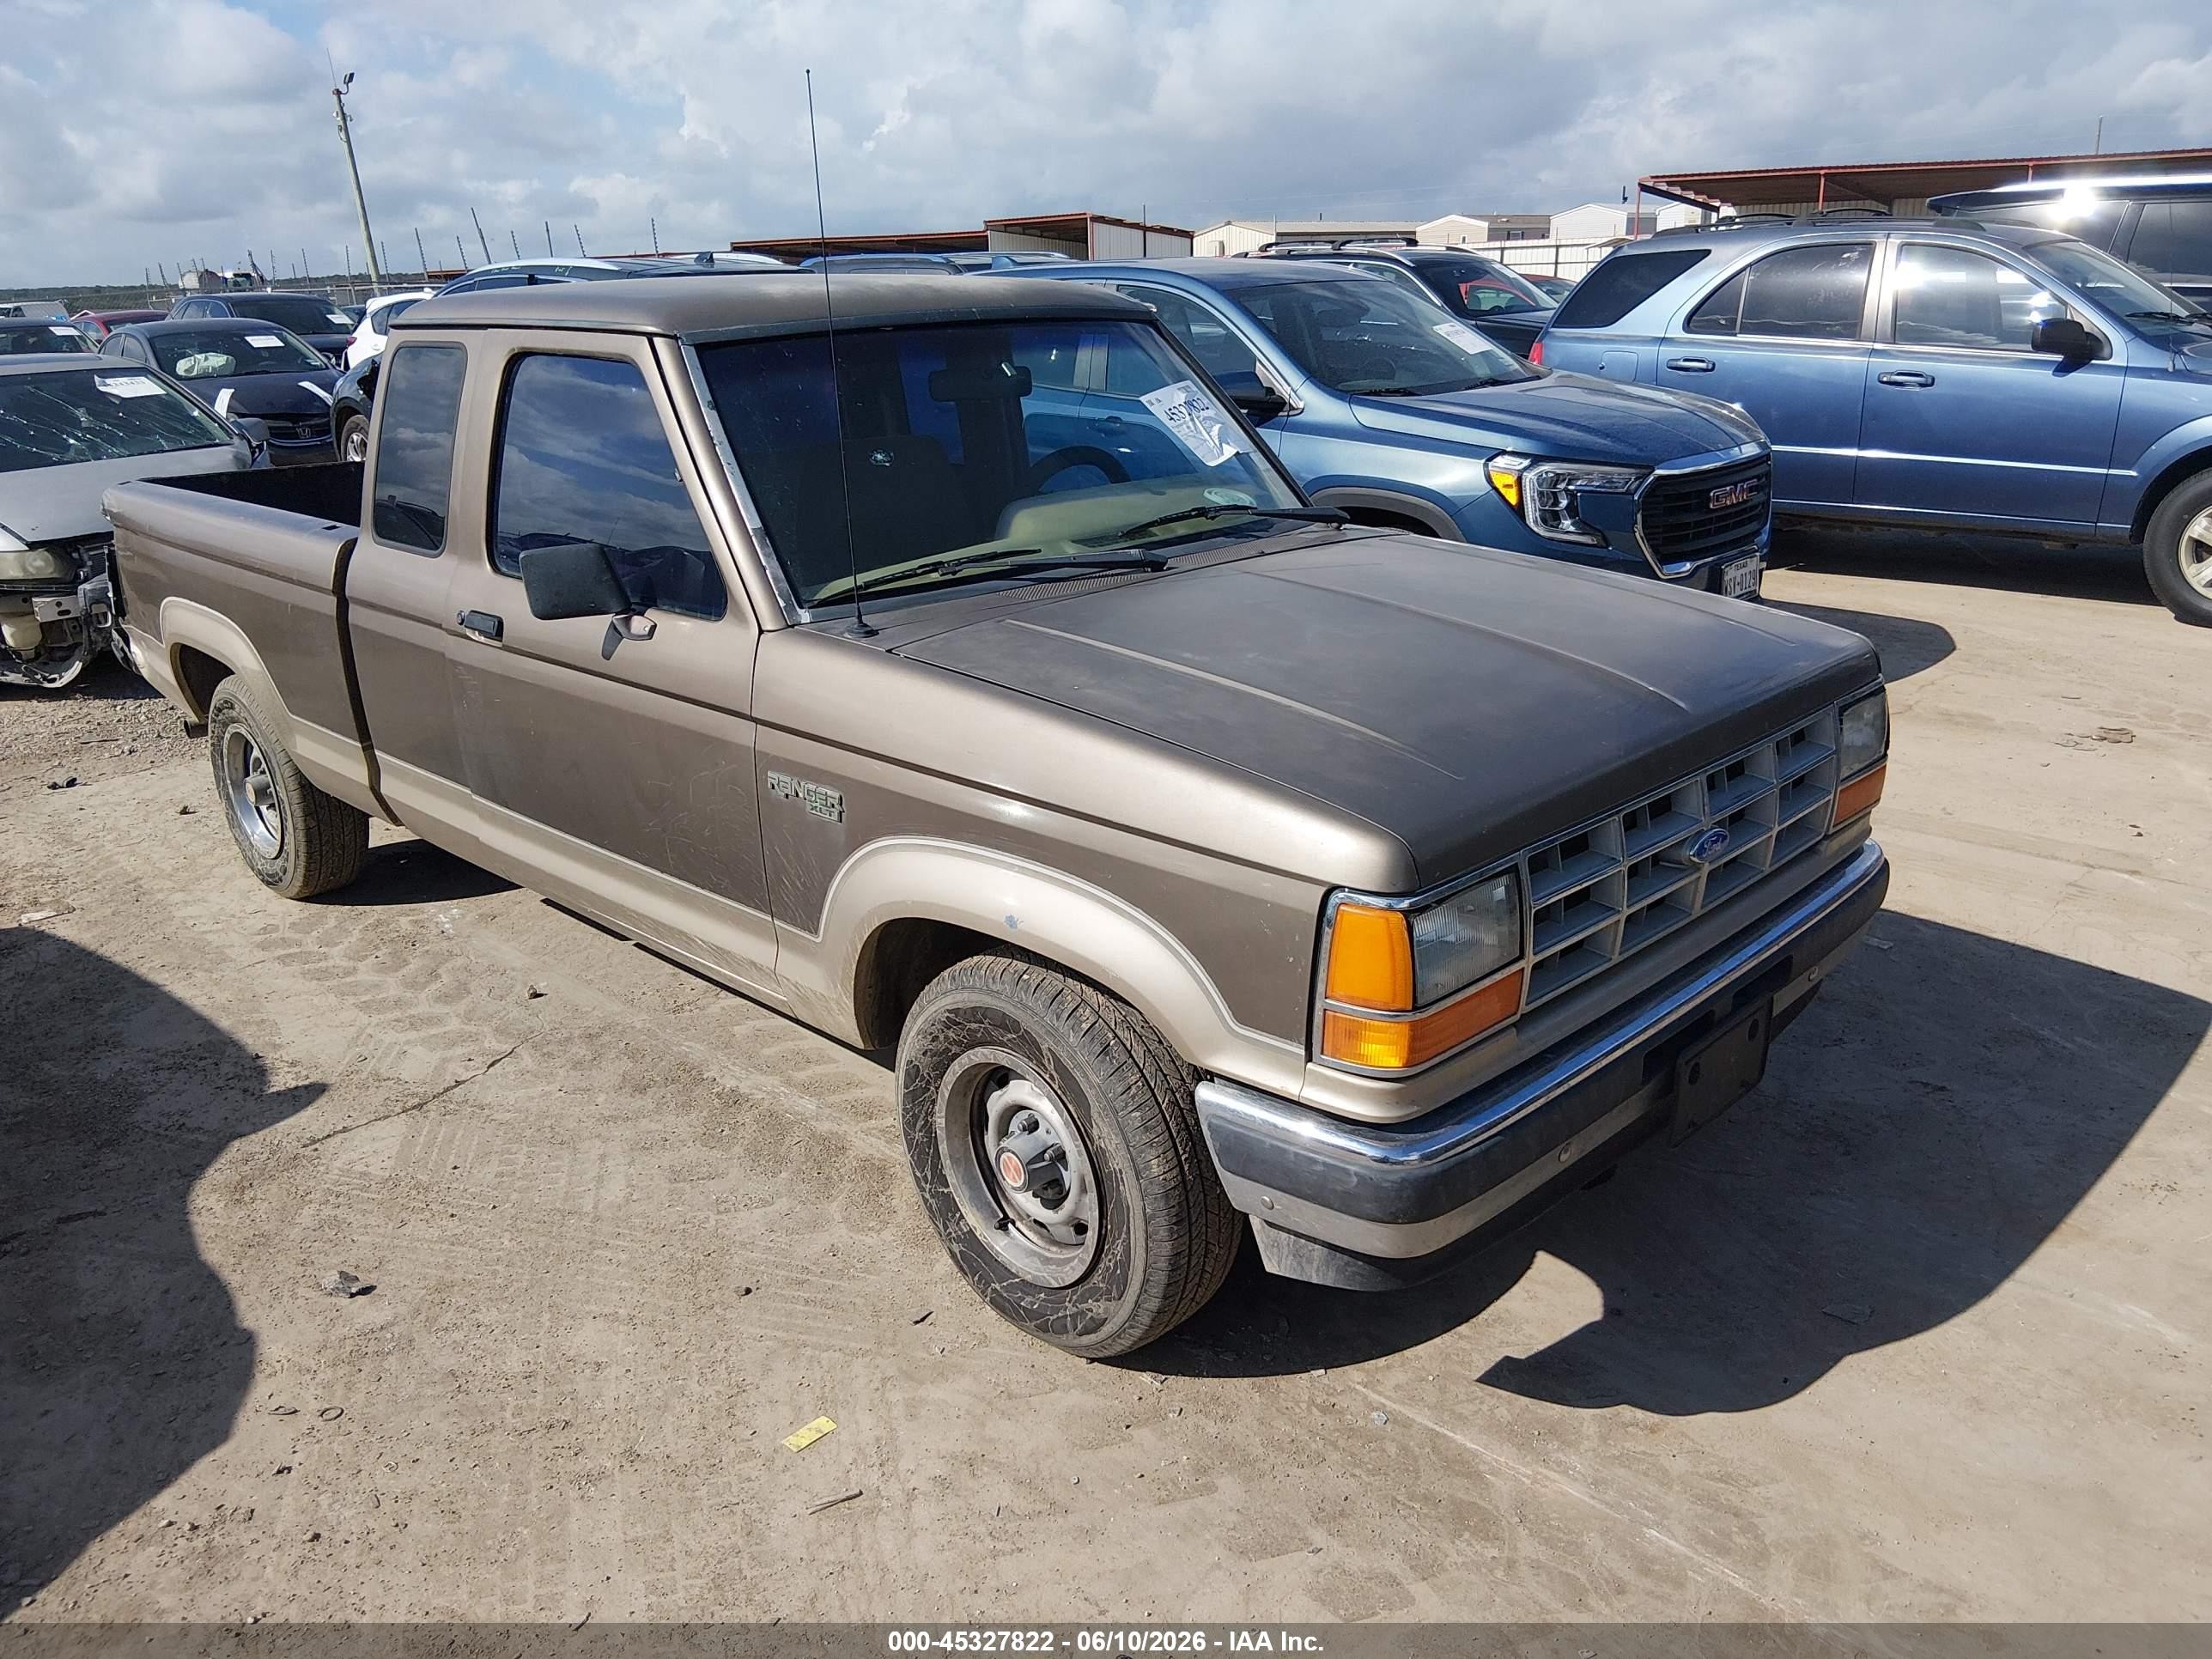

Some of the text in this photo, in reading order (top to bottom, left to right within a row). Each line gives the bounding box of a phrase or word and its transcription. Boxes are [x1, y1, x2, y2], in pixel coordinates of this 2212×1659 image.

[1710, 478, 1759, 509] GMC
[1734, 561, 1748, 572] TEXAS
[768, 770, 845, 813] RANGER
[809, 803, 842, 823] XLT
